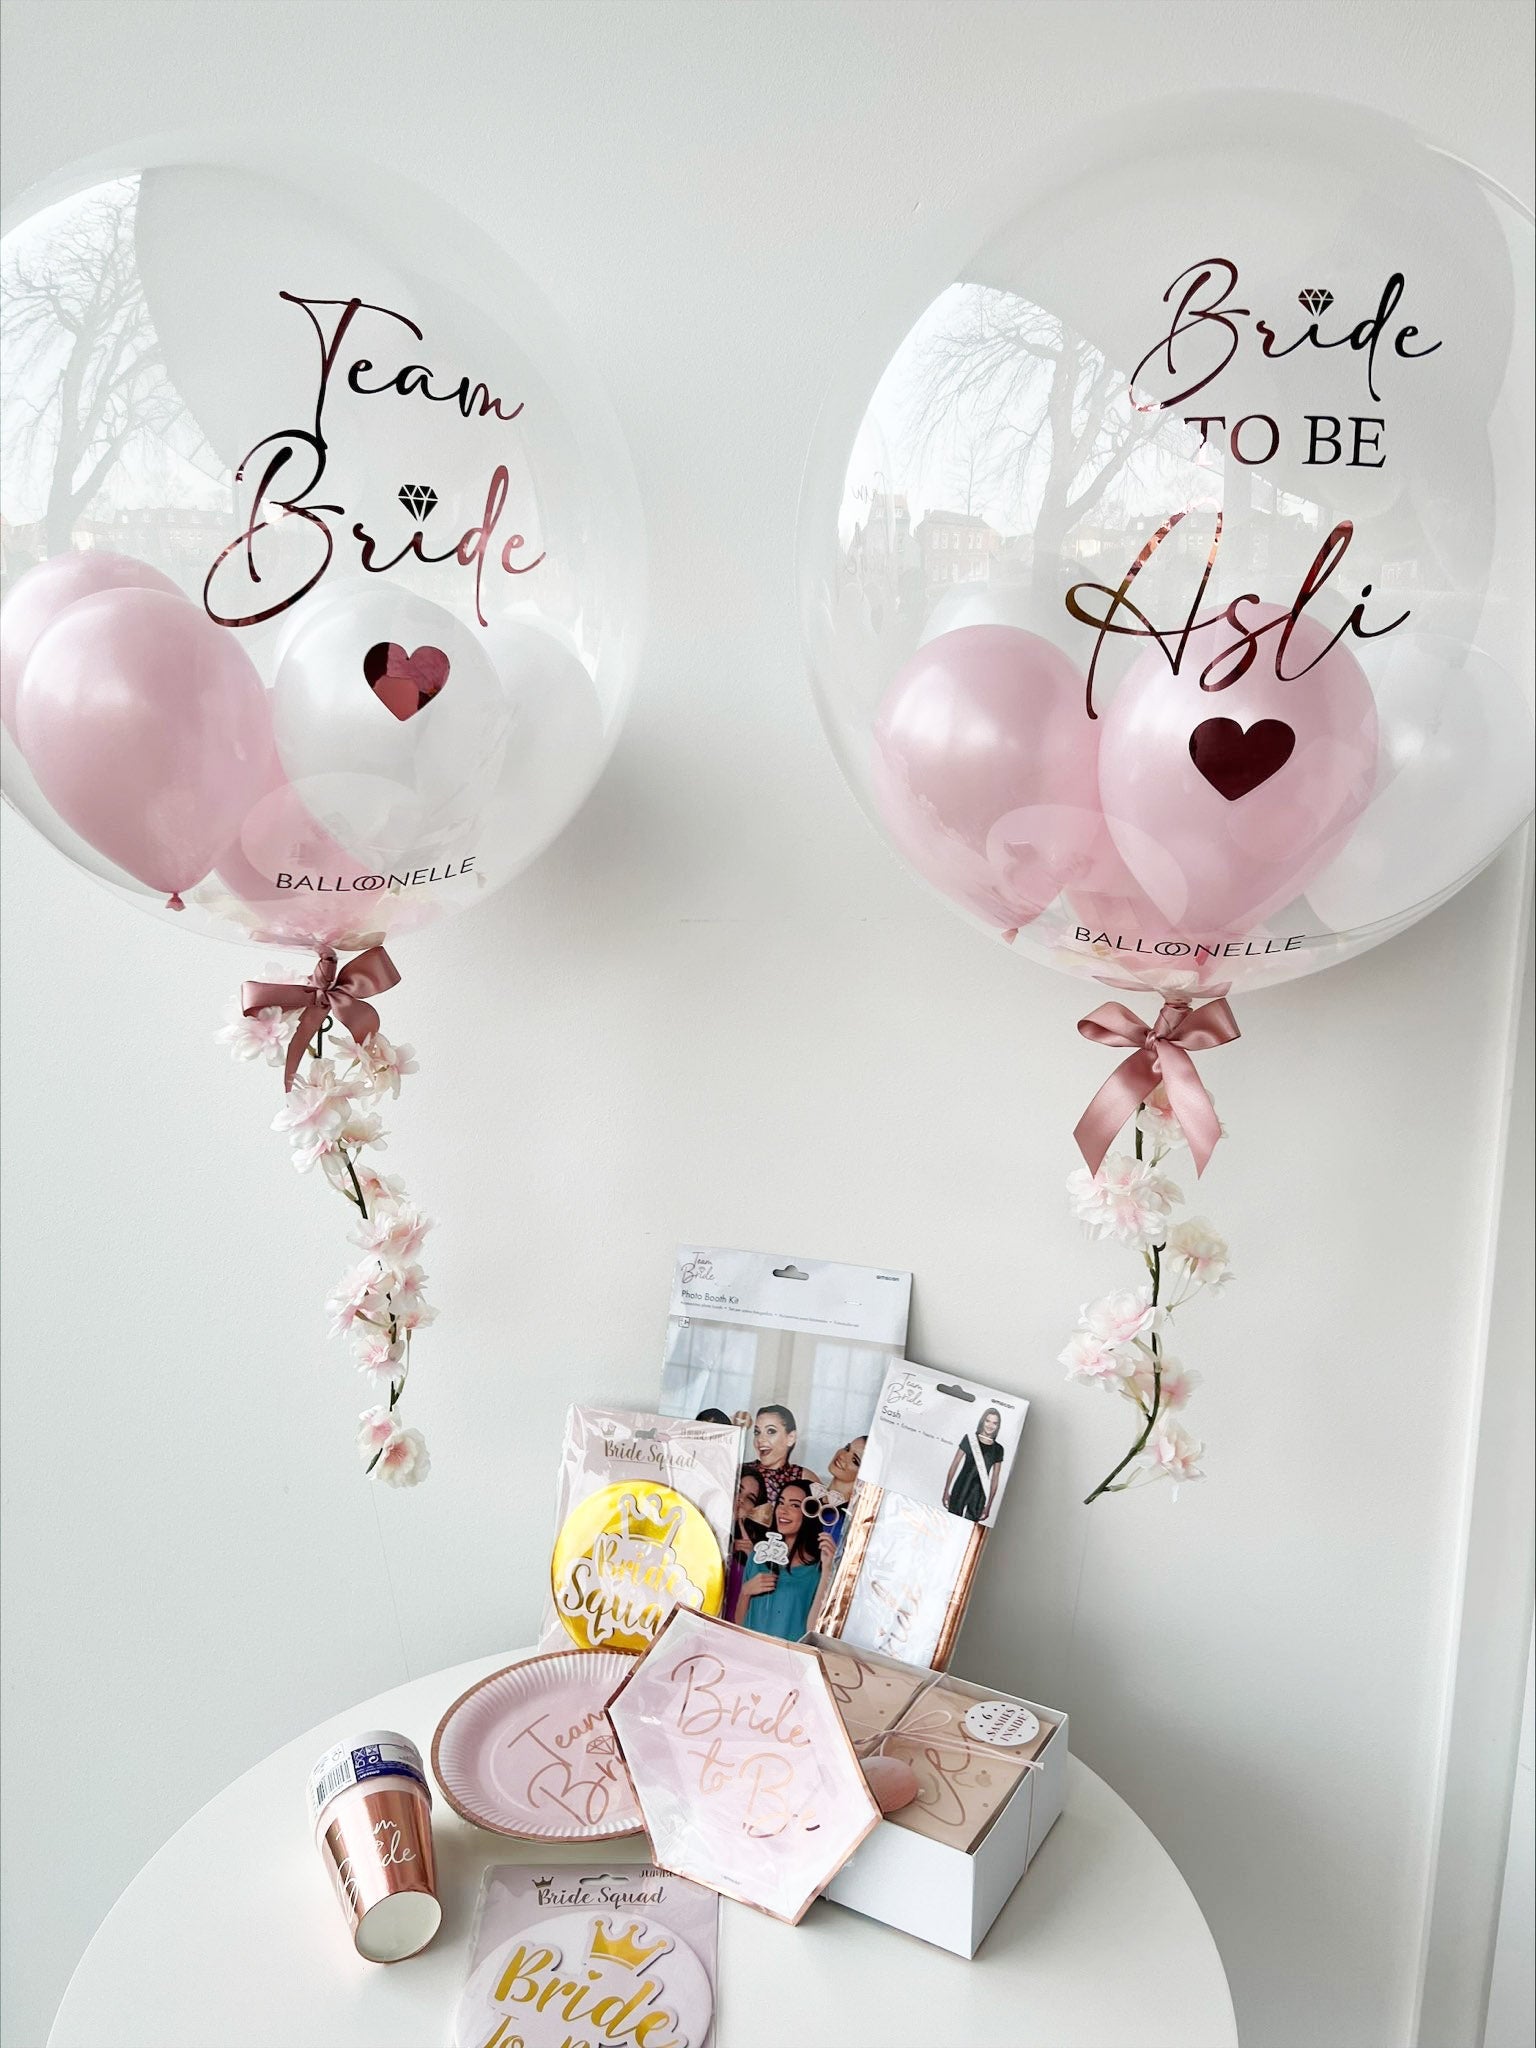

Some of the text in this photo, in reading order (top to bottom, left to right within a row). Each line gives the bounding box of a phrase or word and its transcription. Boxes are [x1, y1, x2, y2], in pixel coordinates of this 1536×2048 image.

[1128, 257, 1442, 413] Bride
[279, 290, 525, 450] Team
[1184, 414, 1387, 468] TO BE
[203, 428, 547, 628] Bride
[1065, 500, 1411, 720] Asli
[276, 856, 476, 892] BALLOONELLE
[1075, 926, 1306, 957] BALLOONELLE
[681, 1289, 702, 1301] Photo
[704, 1293, 727, 1304] Booth
[728, 1296, 740, 1305] Kit
[881, 1405, 902, 1419] Sash
[604, 1440, 698, 1472] Bride Squad
[563, 1563, 664, 1639] Squa
[671, 1653, 811, 1748] Bride
[986, 1709, 1016, 1735] SASHES
[687, 1737, 736, 1796] to
[538, 1886, 668, 1909] Bride Squad
[494, 1945, 680, 2048] Bride
